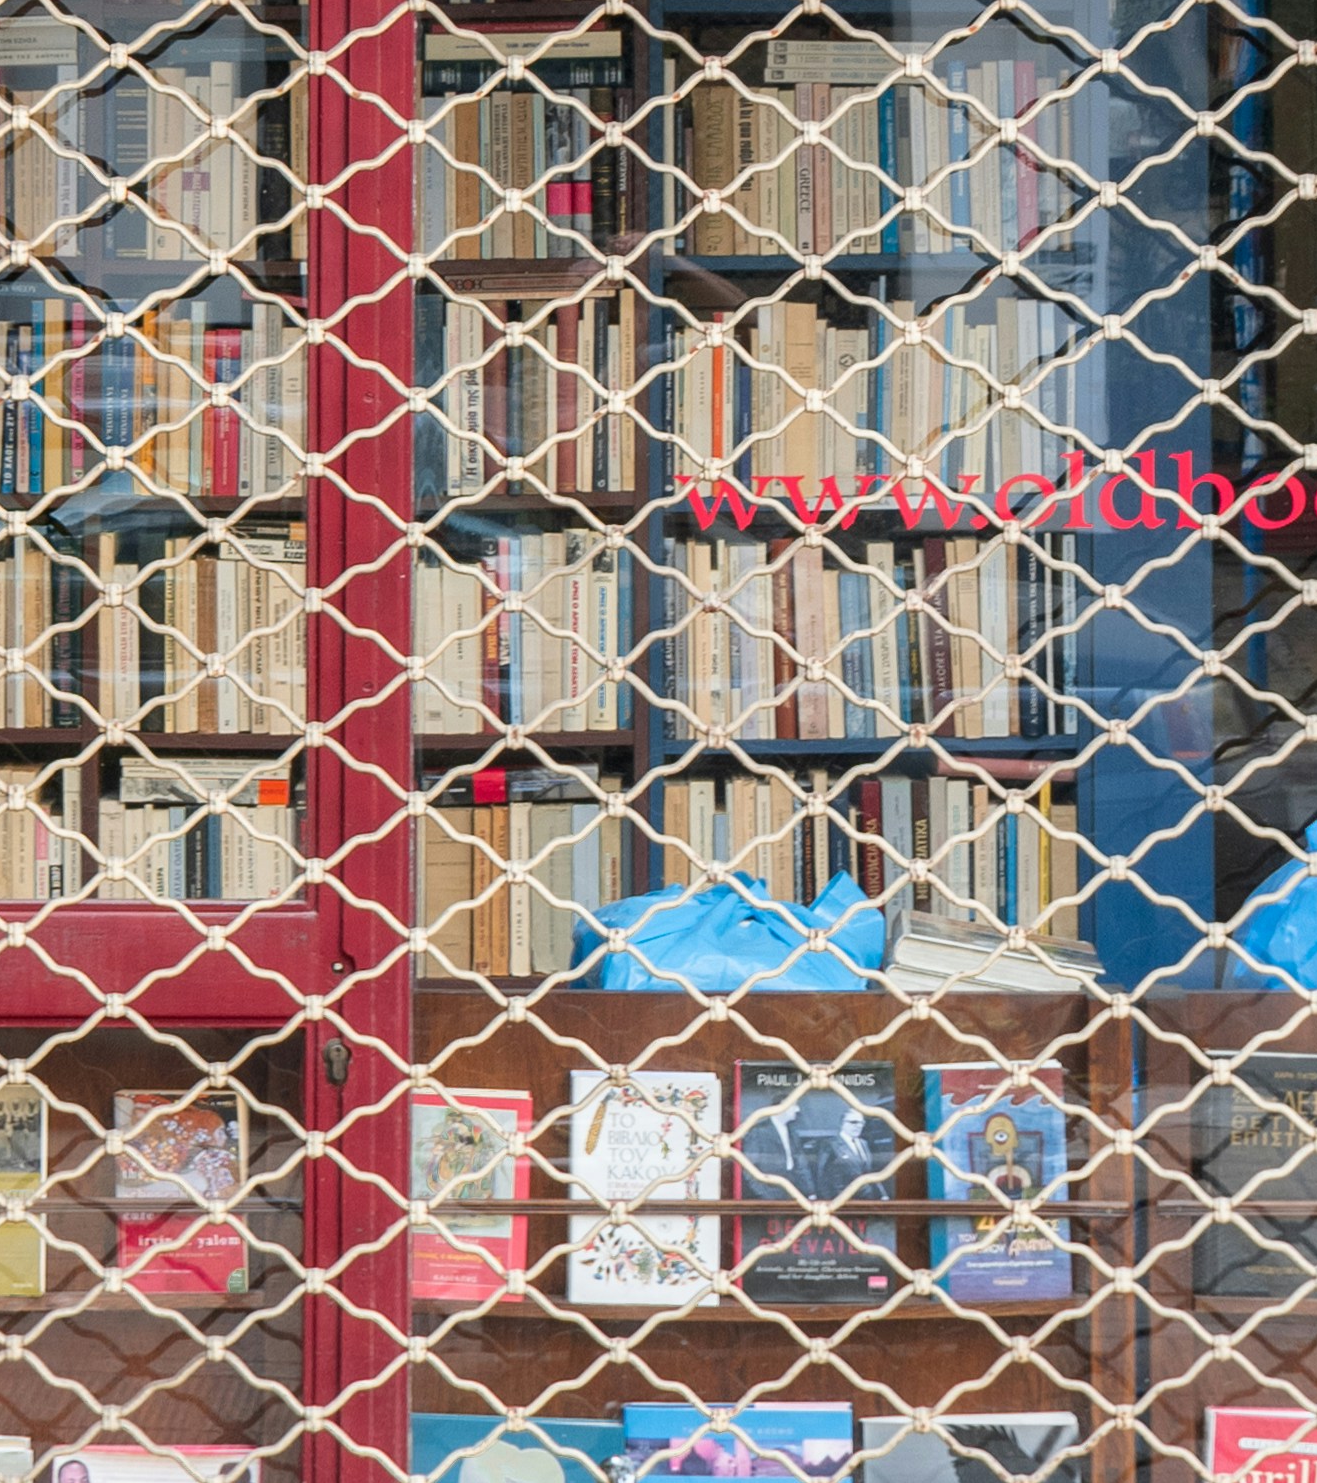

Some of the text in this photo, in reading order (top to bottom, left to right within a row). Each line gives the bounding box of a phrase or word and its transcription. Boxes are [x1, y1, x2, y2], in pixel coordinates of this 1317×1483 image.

[799, 167, 811, 214] GREECE
[756, 1073, 792, 1087] PAUL
[606, 1112, 636, 1130] ΤΟ
[196, 1234, 242, 1251] yalom
